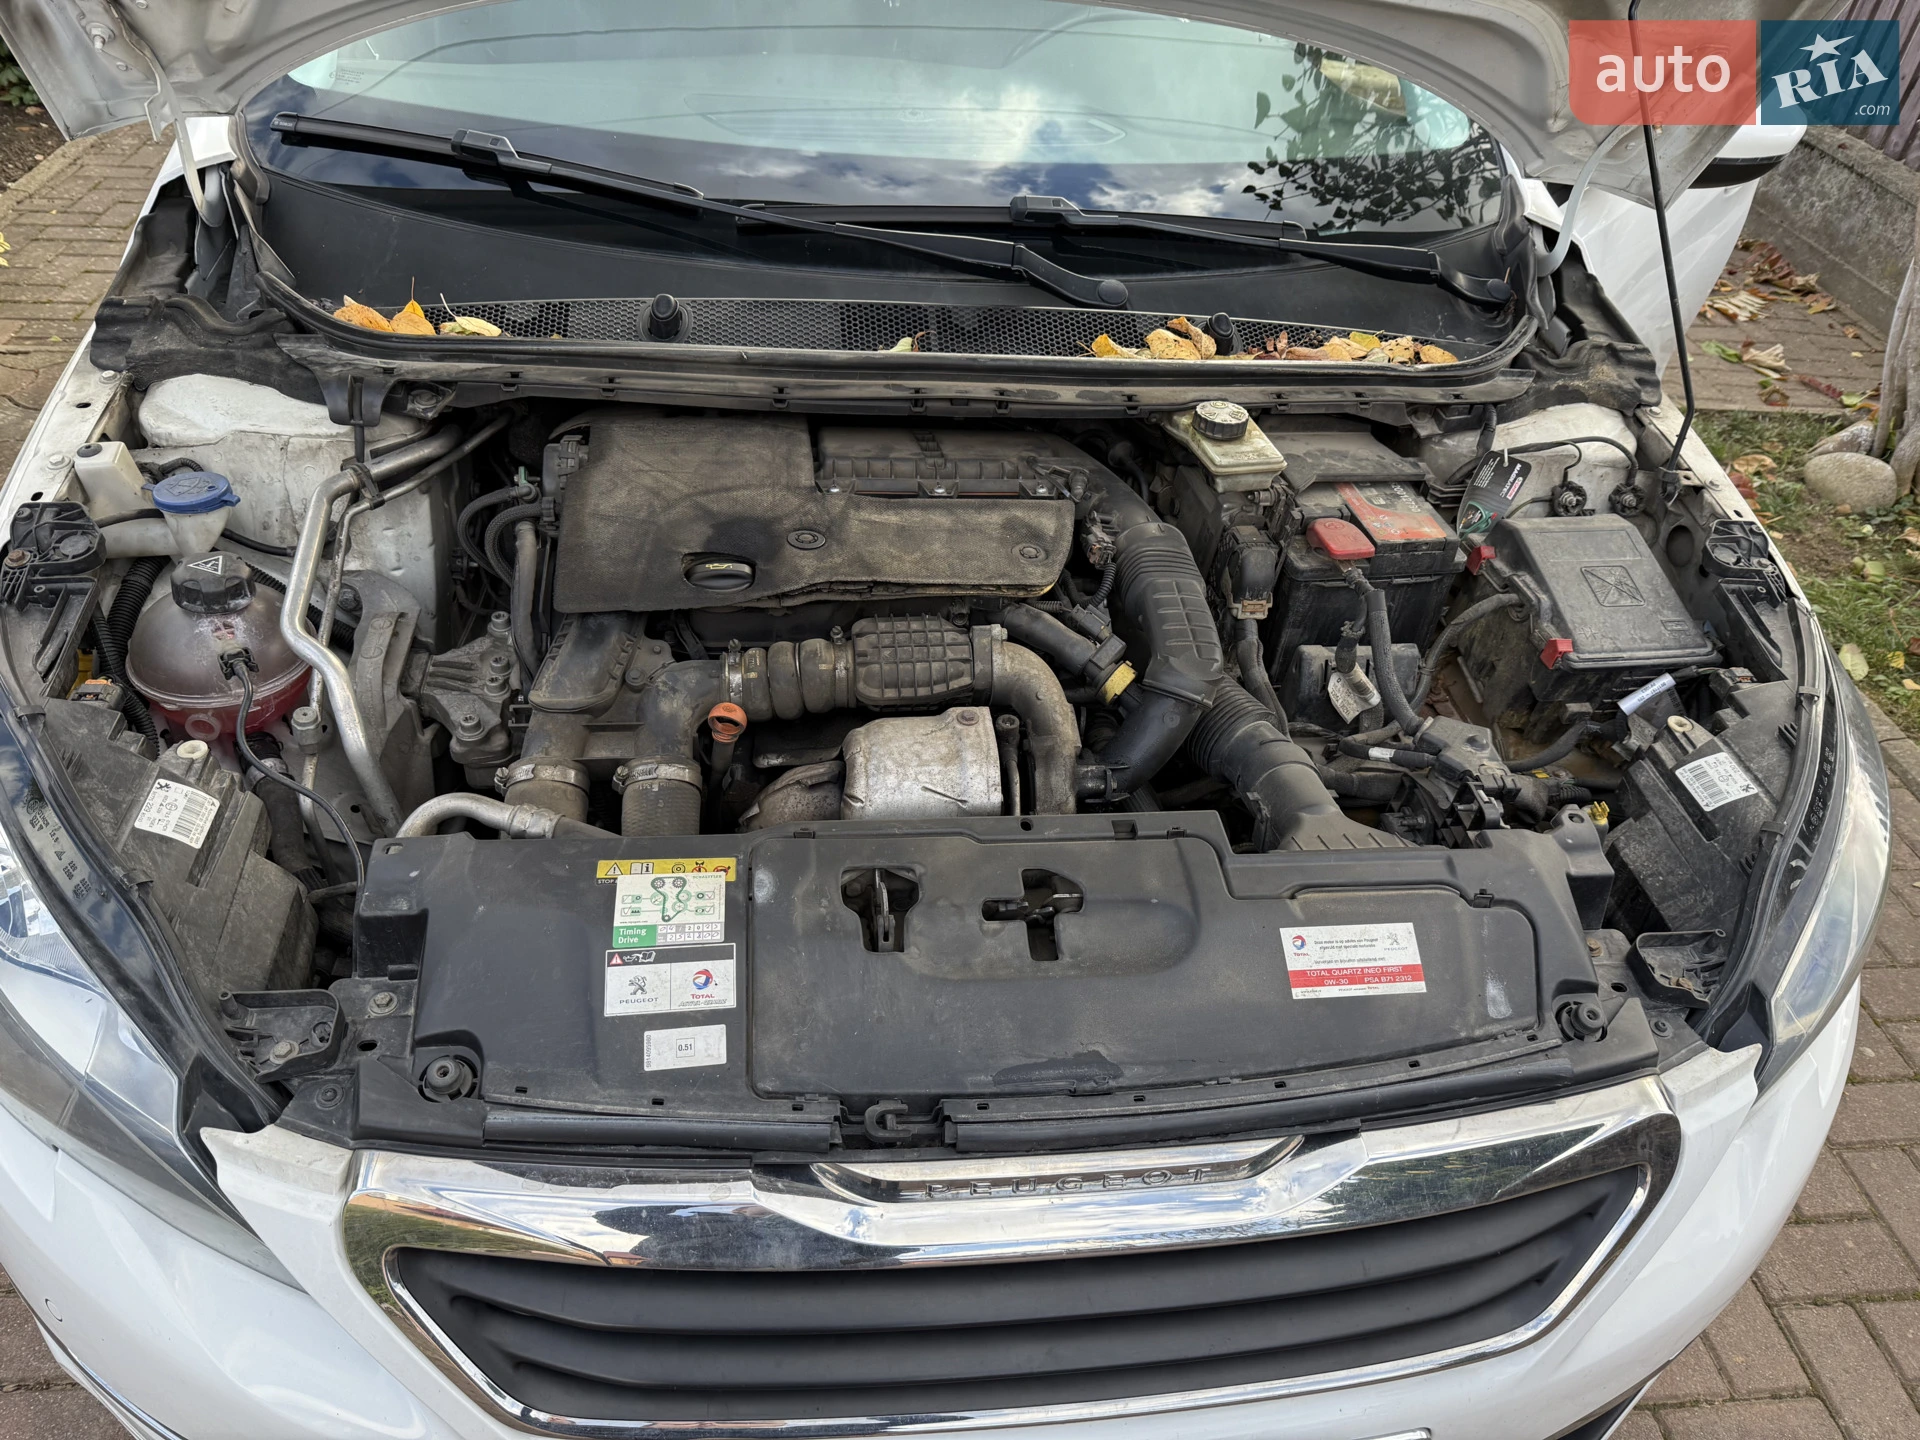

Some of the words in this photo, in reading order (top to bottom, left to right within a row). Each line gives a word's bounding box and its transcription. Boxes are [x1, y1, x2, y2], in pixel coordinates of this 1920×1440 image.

[1499, 463, 1522, 498] MAGNATEC
[619, 927, 648, 936] Timing
[618, 936, 639, 944] Drive
[1306, 969, 1330, 977] TOTAL
[1331, 968, 1361, 976] QUARTZ
[924, 1167, 1211, 1198] PEUGEOT
